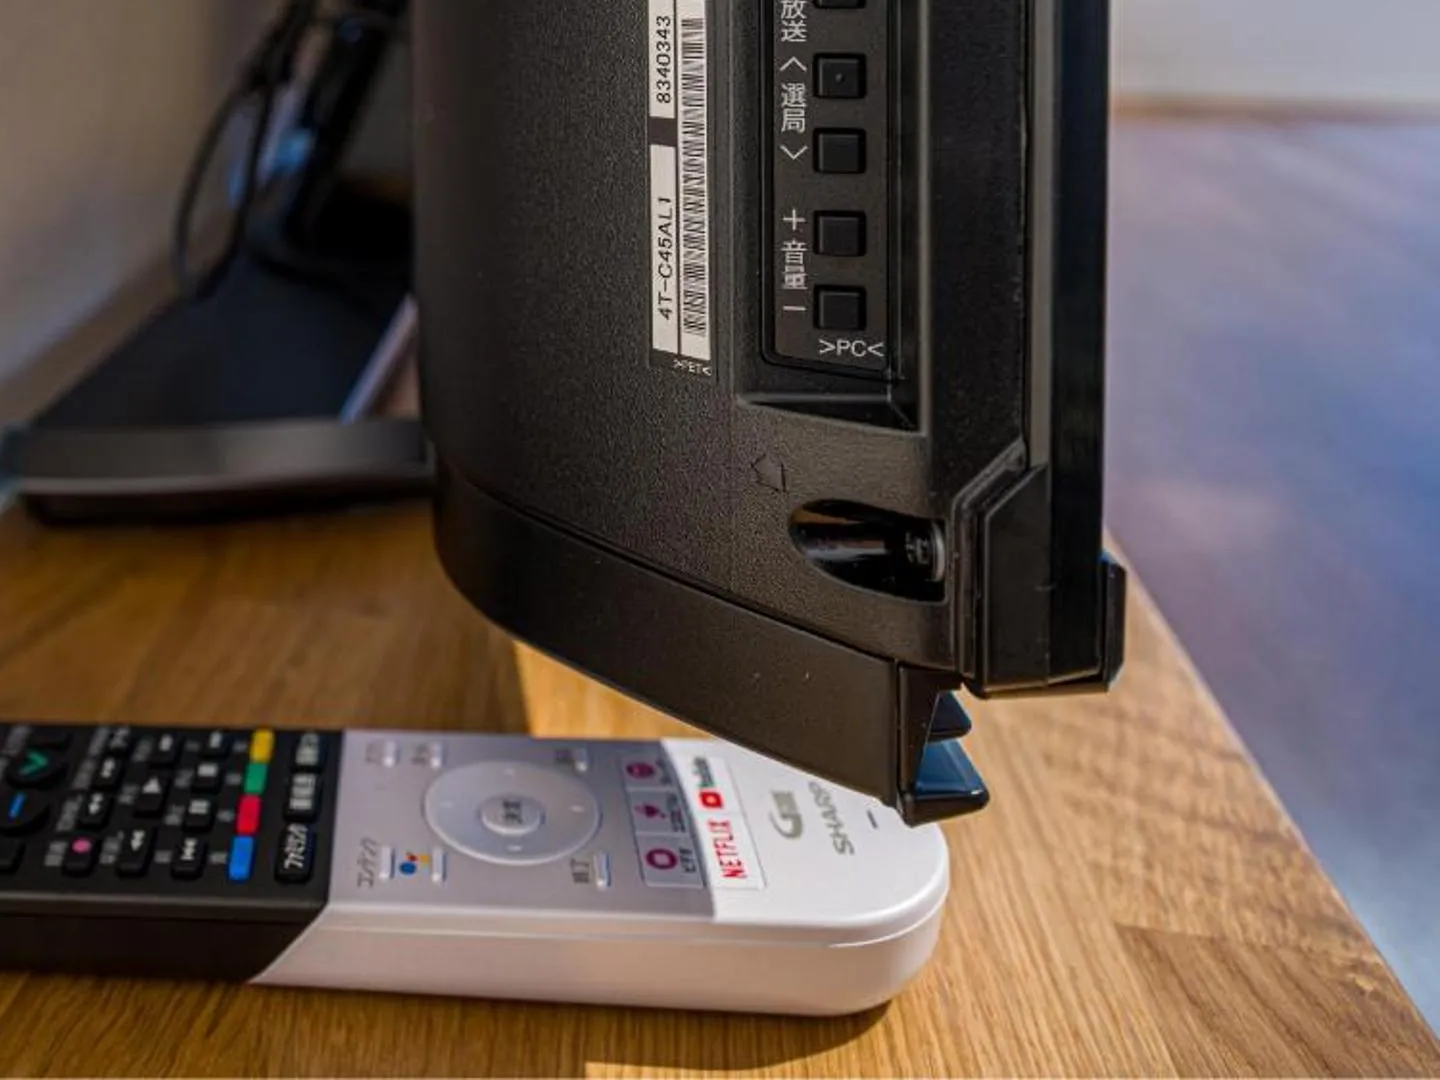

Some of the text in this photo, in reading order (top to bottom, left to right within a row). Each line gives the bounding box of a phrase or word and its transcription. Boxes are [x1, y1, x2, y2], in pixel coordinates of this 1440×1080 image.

[656, 15, 672, 104] 8340343
[780, 82, 807, 134] 選局
[657, 196, 673, 320] 4T-C45AL1
[781, 239, 808, 291] 音量
[707, 819, 748, 880] NETFLIX
[807, 781, 855, 856] SHARP
